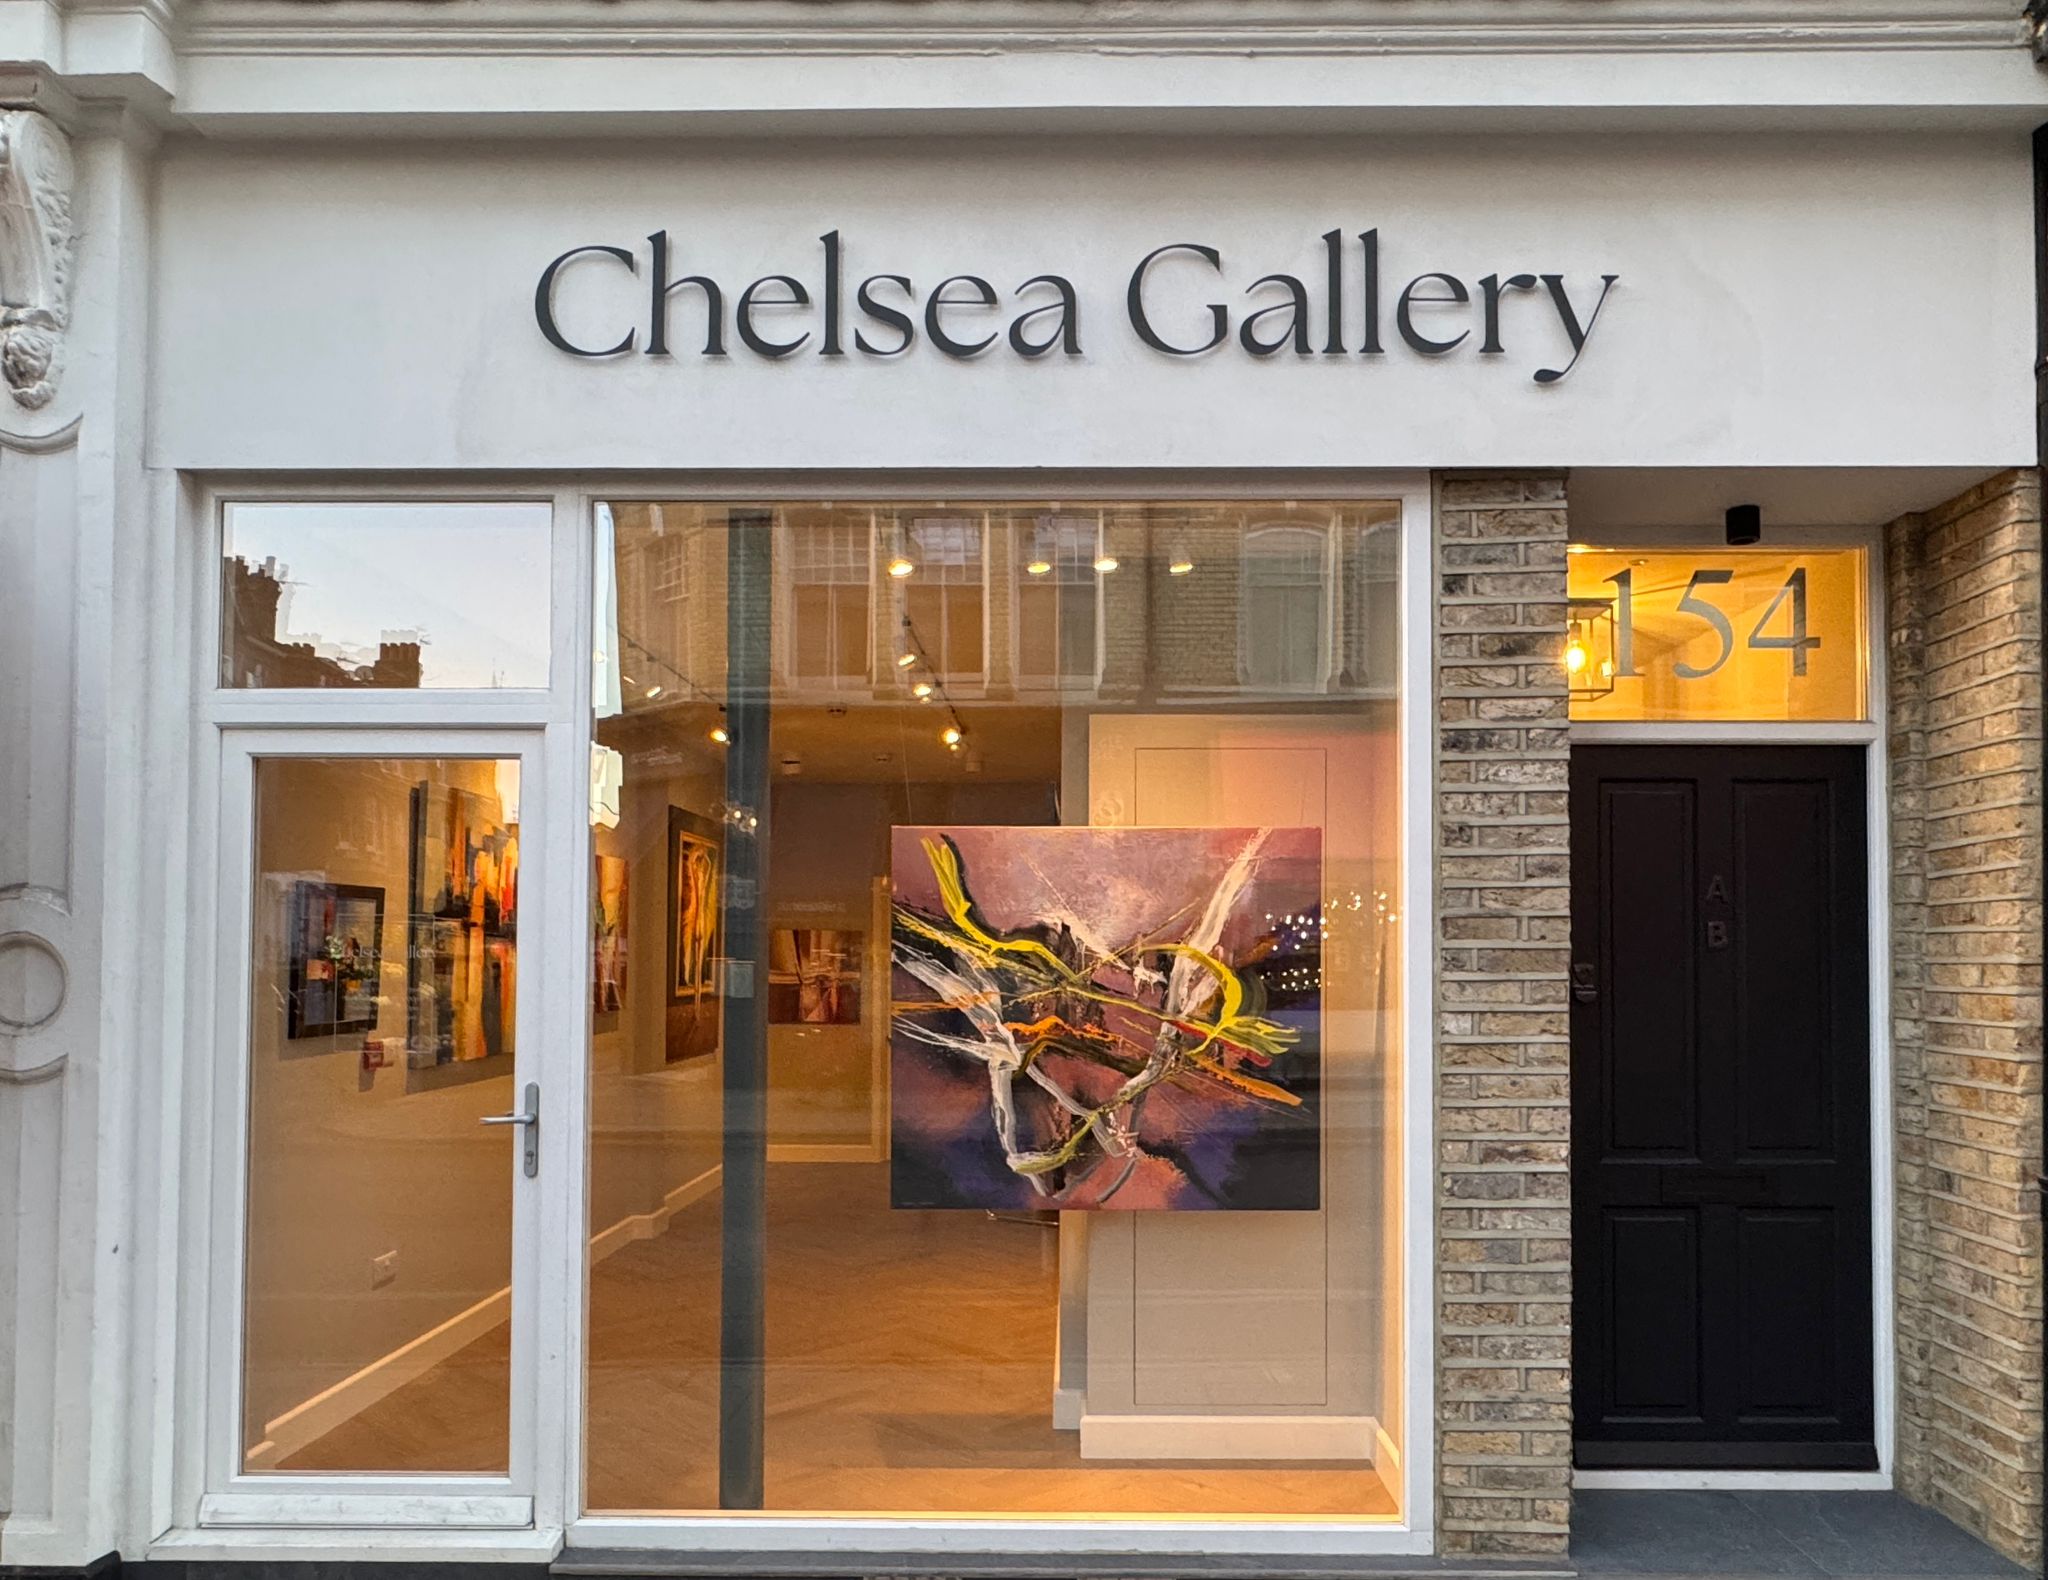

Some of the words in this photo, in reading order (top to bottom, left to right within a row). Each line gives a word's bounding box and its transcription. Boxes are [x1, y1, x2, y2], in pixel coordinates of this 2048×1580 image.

[534, 229, 1084, 362] Chelsea
[1127, 228, 1620, 385] Gallery
[1602, 566, 1822, 679] 154
[1706, 873, 1729, 902] A
[1706, 920, 1729, 948] B
